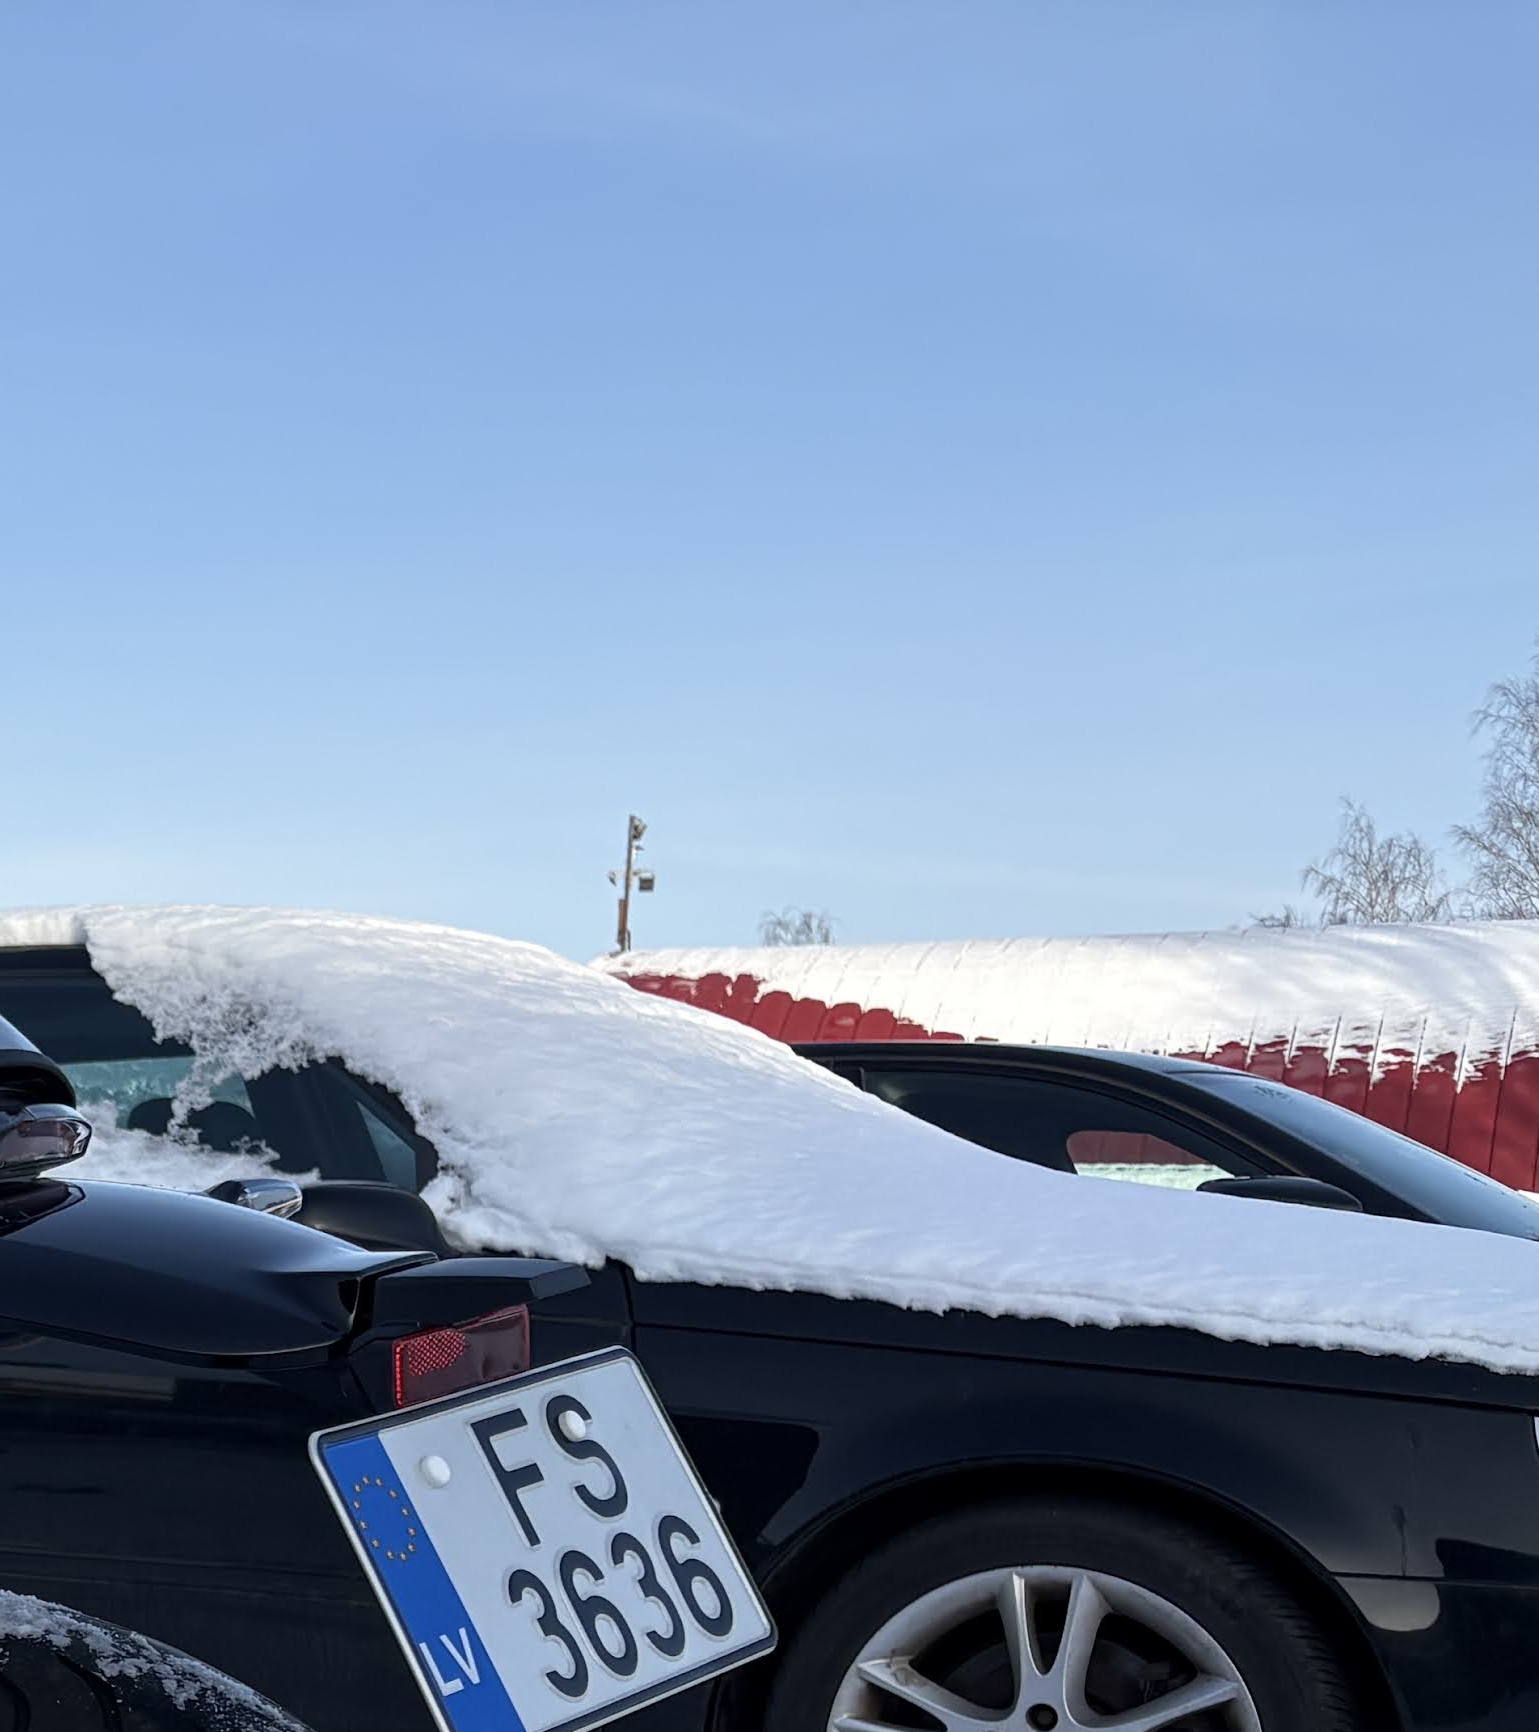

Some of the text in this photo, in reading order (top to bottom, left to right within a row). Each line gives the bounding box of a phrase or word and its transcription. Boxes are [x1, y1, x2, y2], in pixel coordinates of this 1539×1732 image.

[468, 1394, 629, 1548] FS
[418, 1626, 481, 1697] LV
[507, 1514, 734, 1699] 3636
